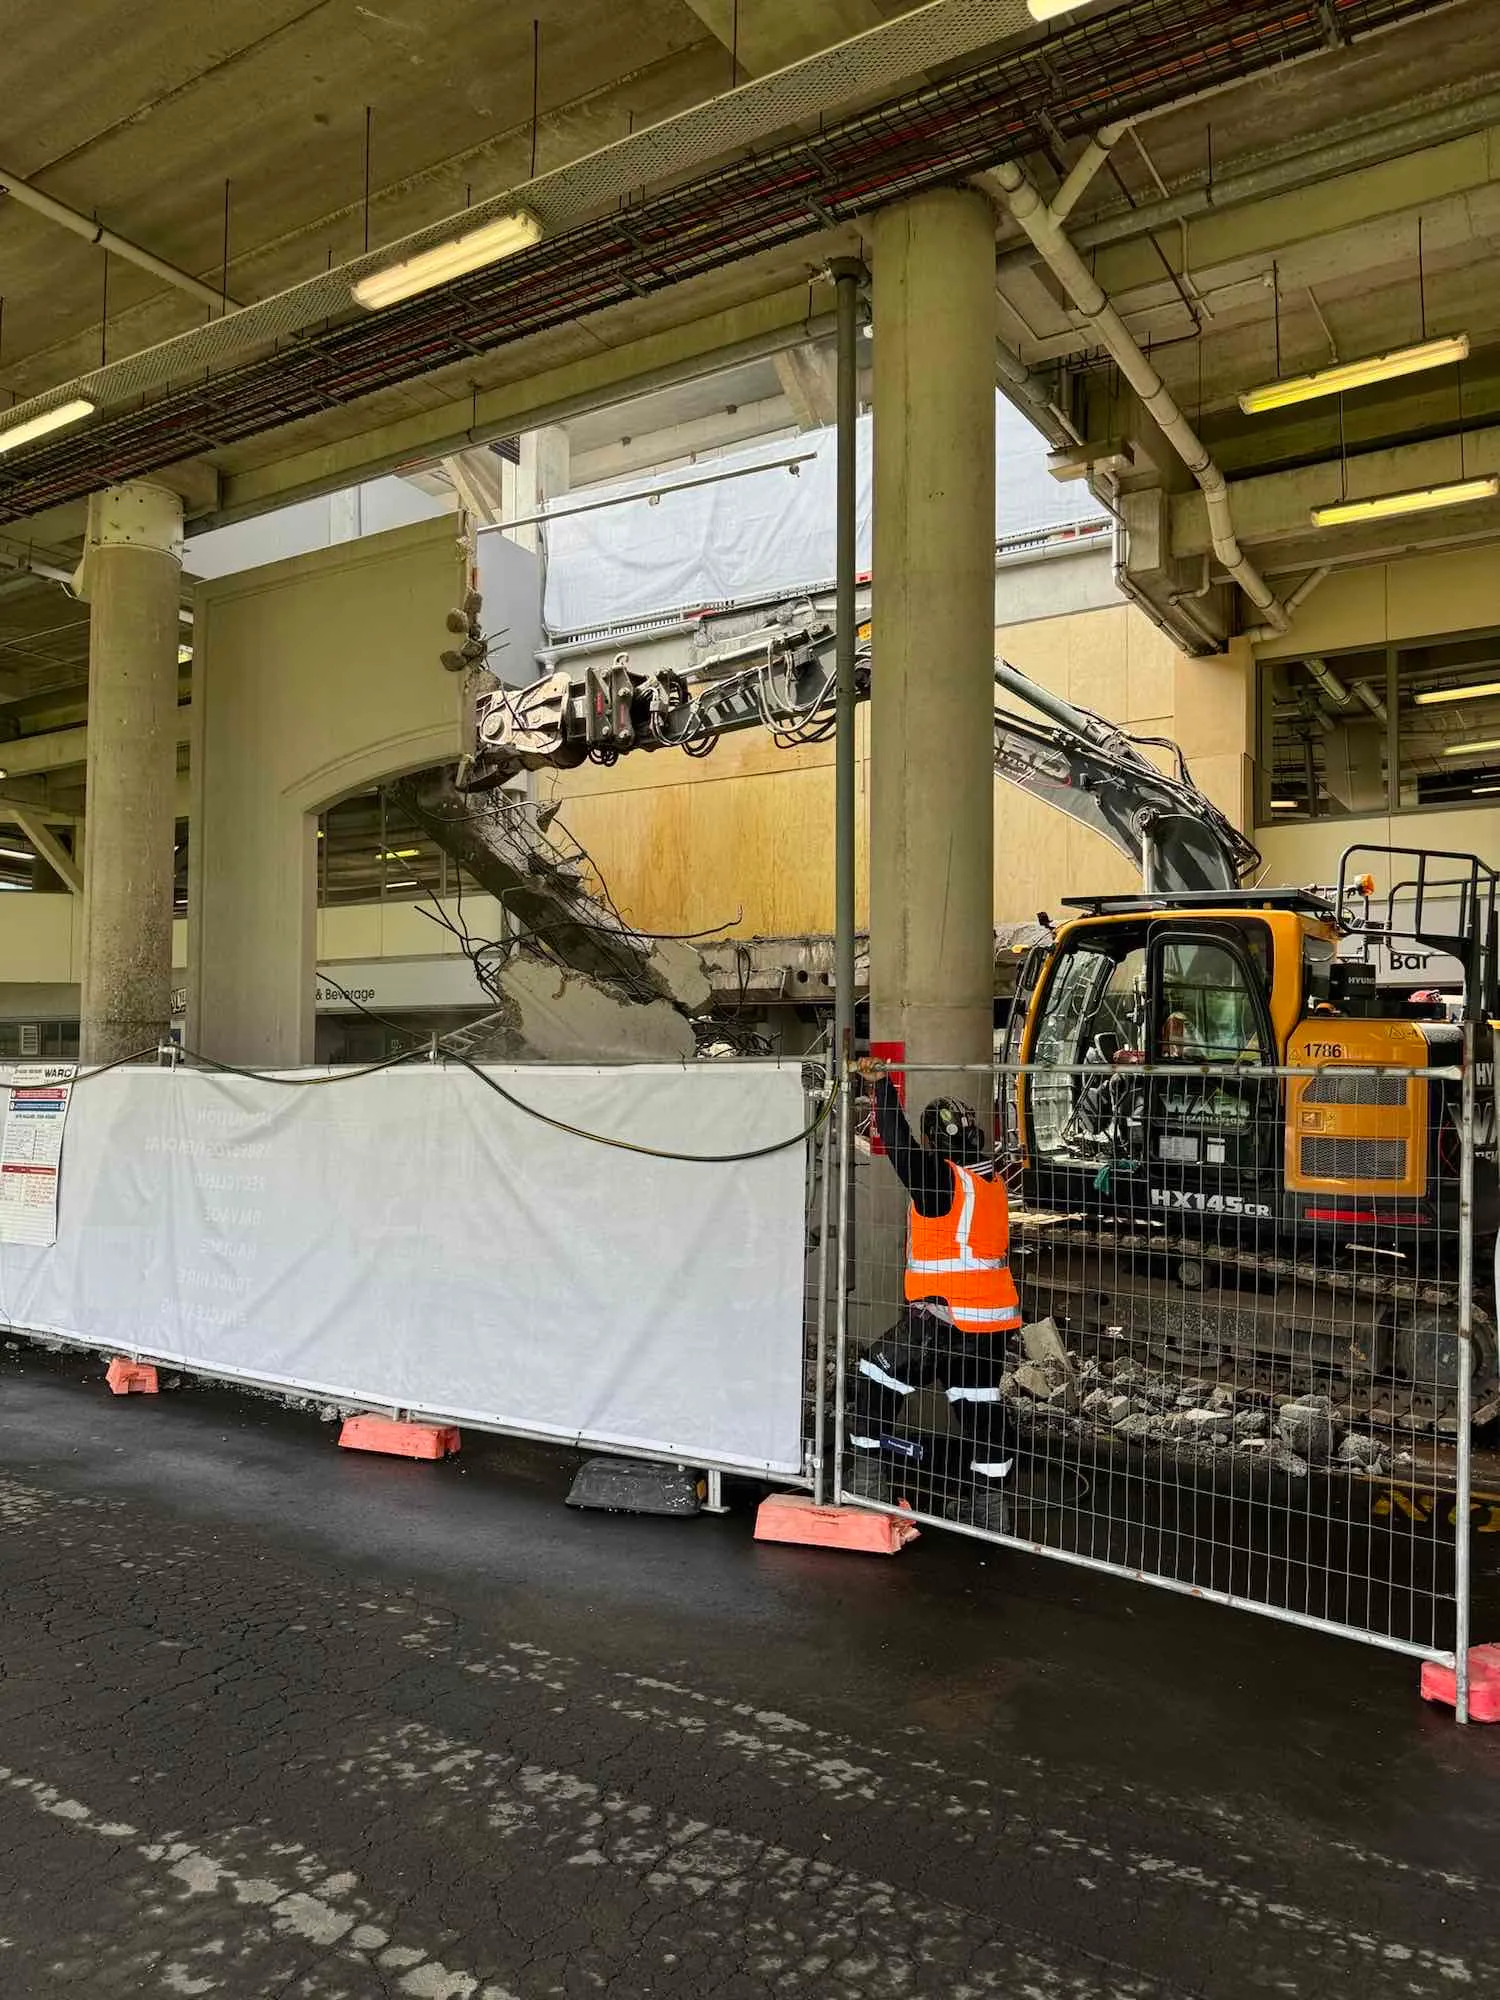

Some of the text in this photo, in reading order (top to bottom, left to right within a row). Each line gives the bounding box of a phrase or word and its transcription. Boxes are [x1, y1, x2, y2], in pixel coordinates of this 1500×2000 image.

[1390, 952, 1431, 970] Bar
[315, 986, 376, 1002] & Beverage
[1303, 1043, 1342, 1058] 1786
[44, 1068, 72, 1079] WARD
